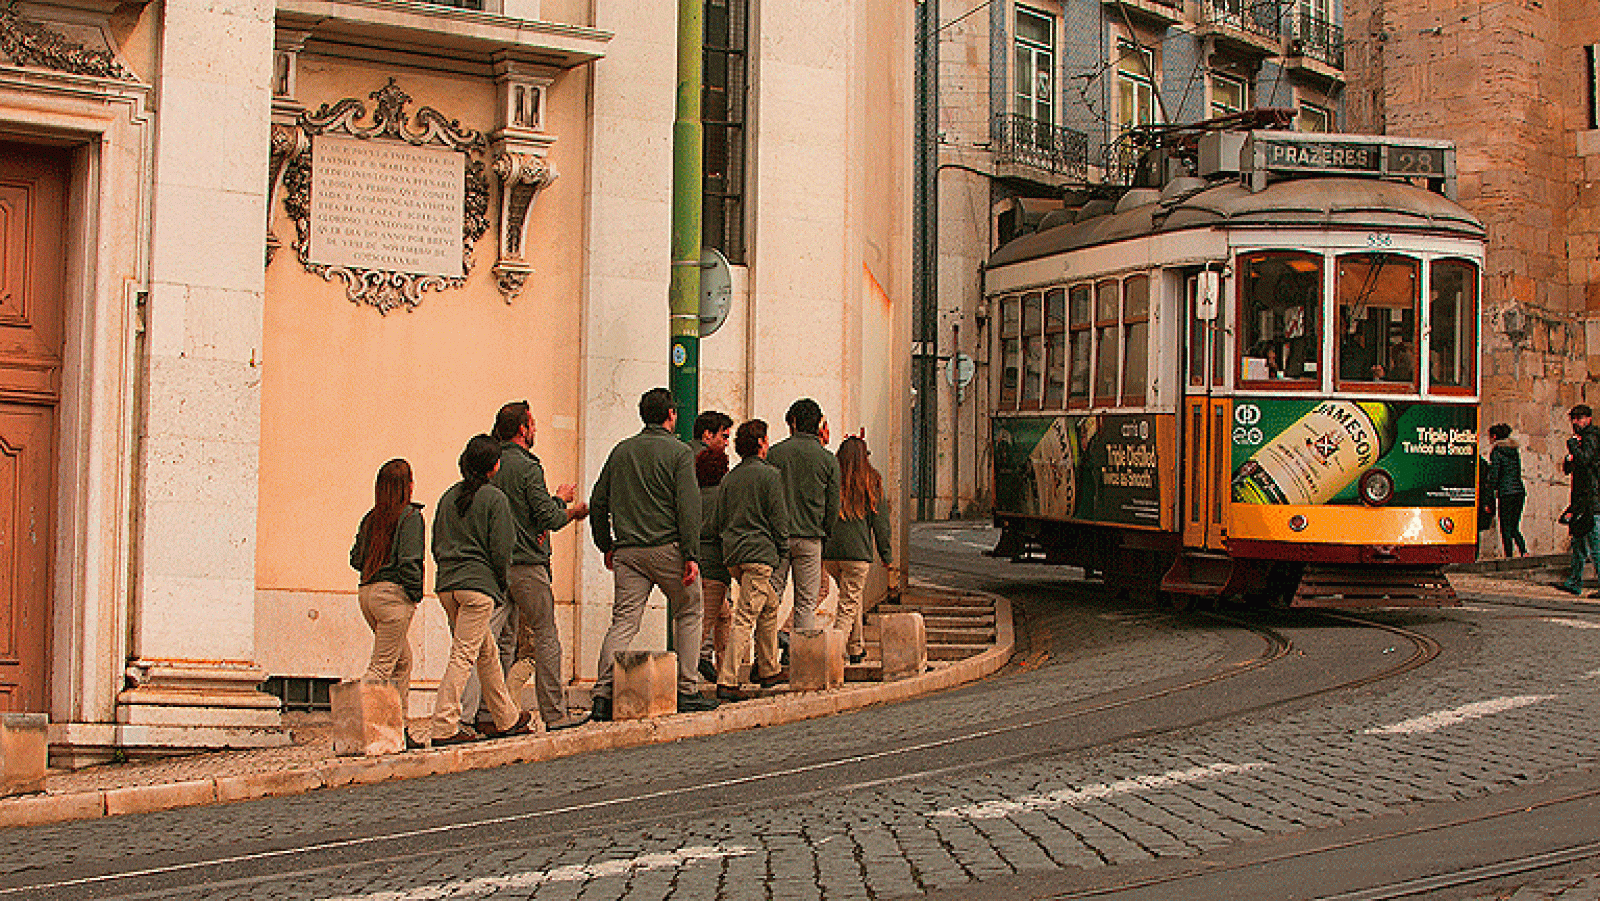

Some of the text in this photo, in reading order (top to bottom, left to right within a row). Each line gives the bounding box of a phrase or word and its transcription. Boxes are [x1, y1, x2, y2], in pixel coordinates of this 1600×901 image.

[1274, 144, 1433, 174] PRAZERES 28
[1416, 427, 1448, 445] Triple
[1402, 441, 1434, 455] Twice
